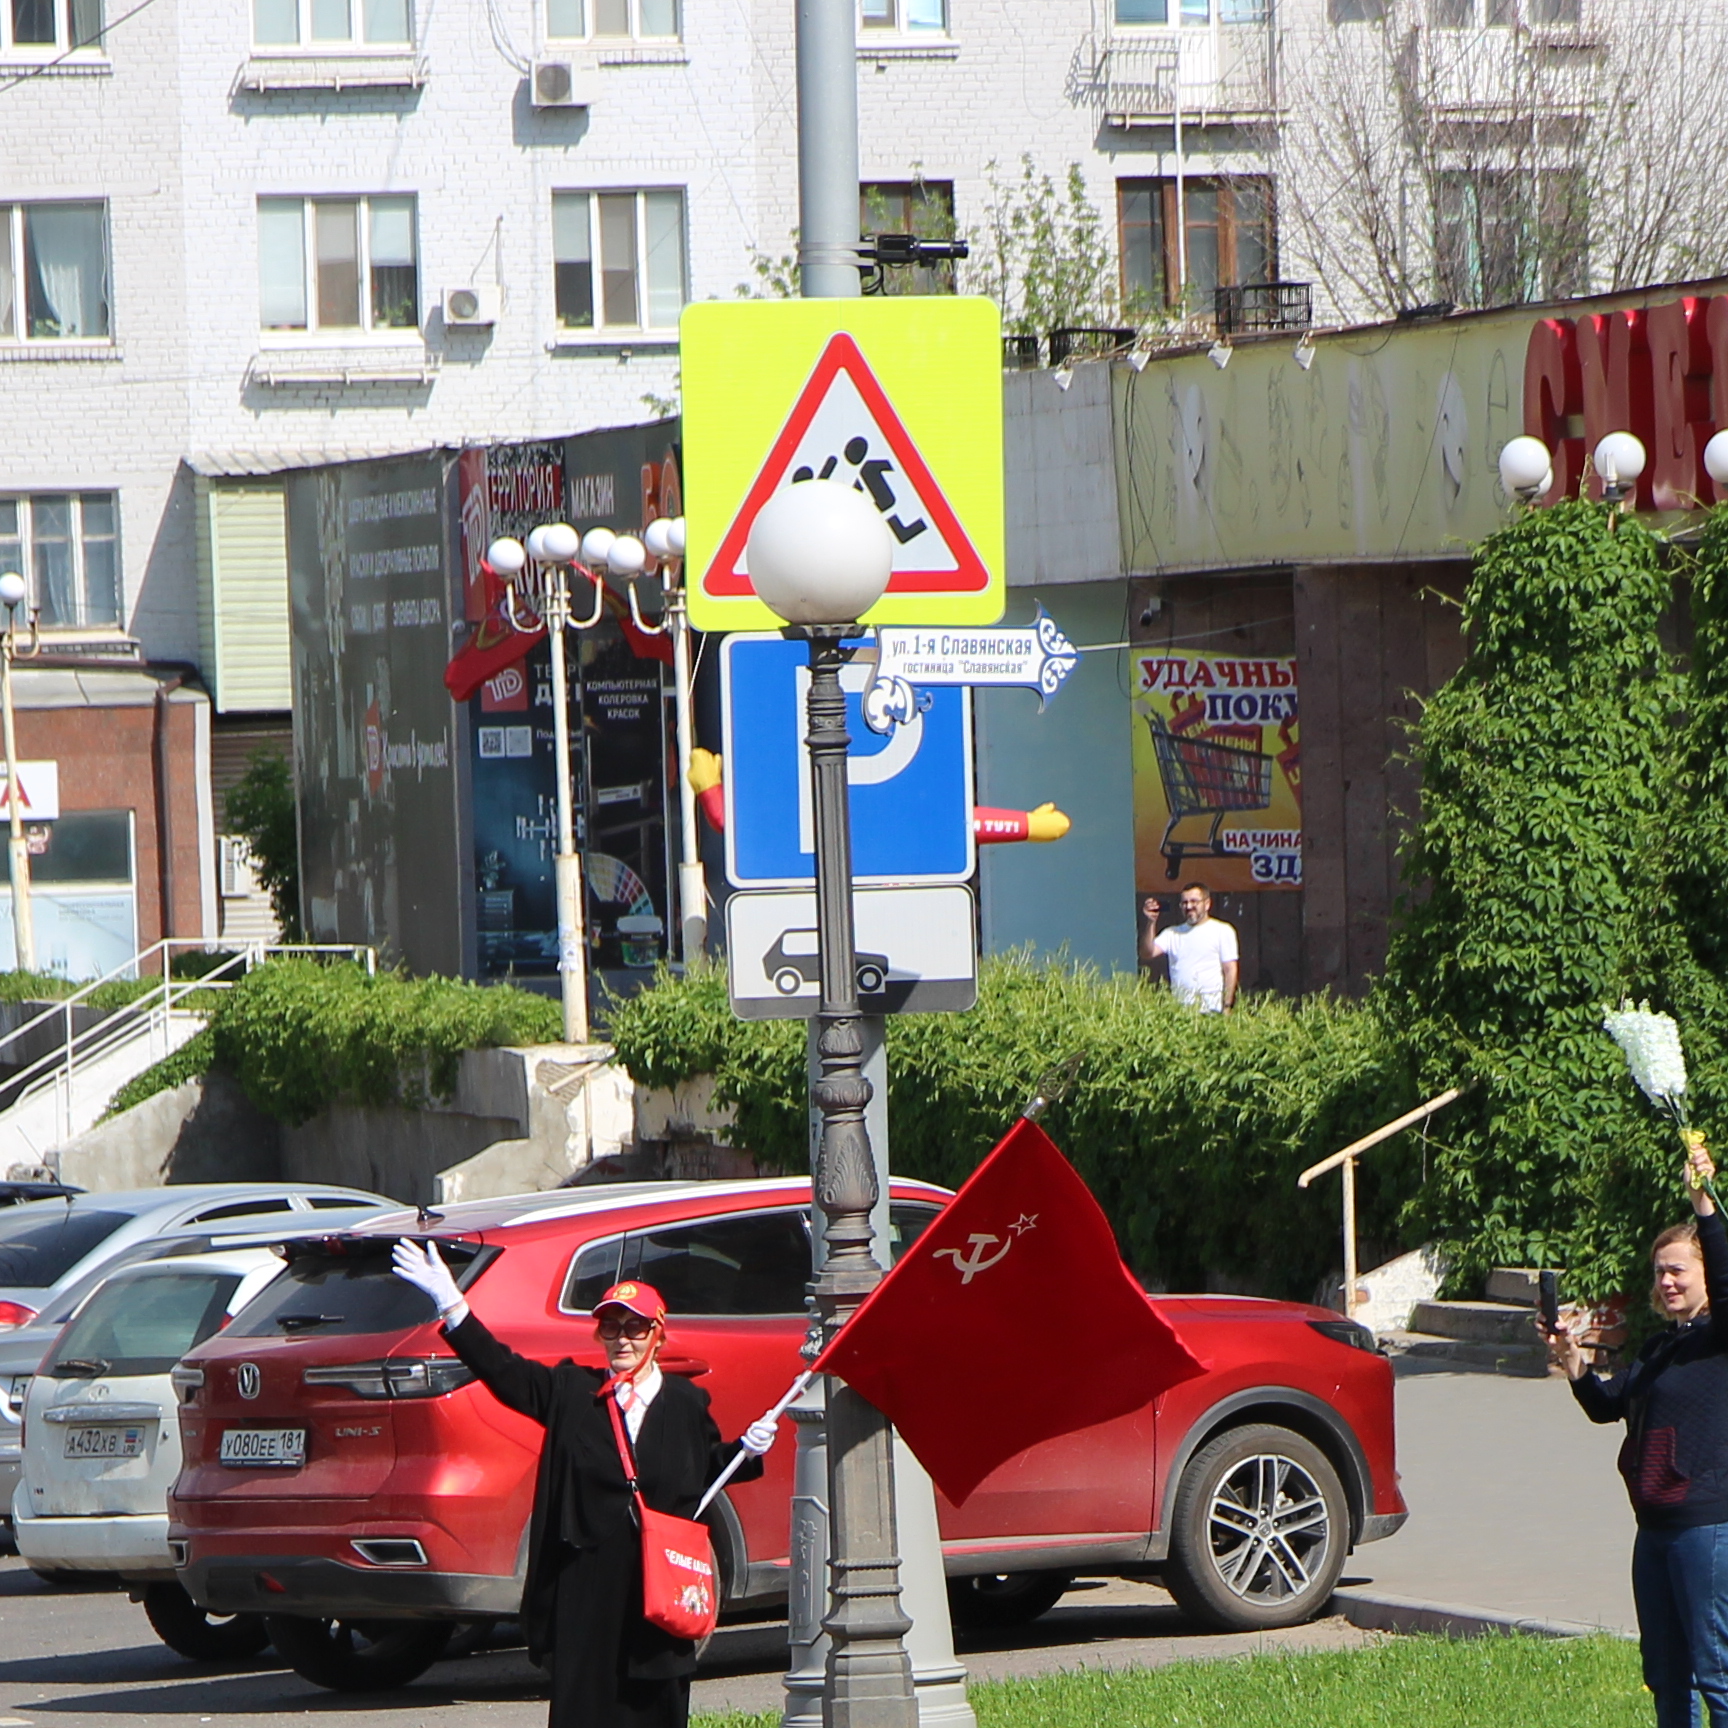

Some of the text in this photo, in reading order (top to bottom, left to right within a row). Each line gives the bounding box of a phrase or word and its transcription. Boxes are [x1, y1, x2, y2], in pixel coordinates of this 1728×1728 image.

[488, 464, 556, 513] ТЕРРИТОРИЯ
[571, 473, 615, 519] МАГАЗИН
[892, 634, 1033, 657] ул. 1-я Славянская
[902, 660, 955, 675] гостиница
[586, 678, 658, 692] КОМПЬЮТЕРНАЯ
[598, 694, 649, 706] КОЛЕРОВКА
[607, 708, 641, 720] КРАСОК
[334, 1426, 383, 1438] UNI-S
[279, 1431, 301, 1451] 181
